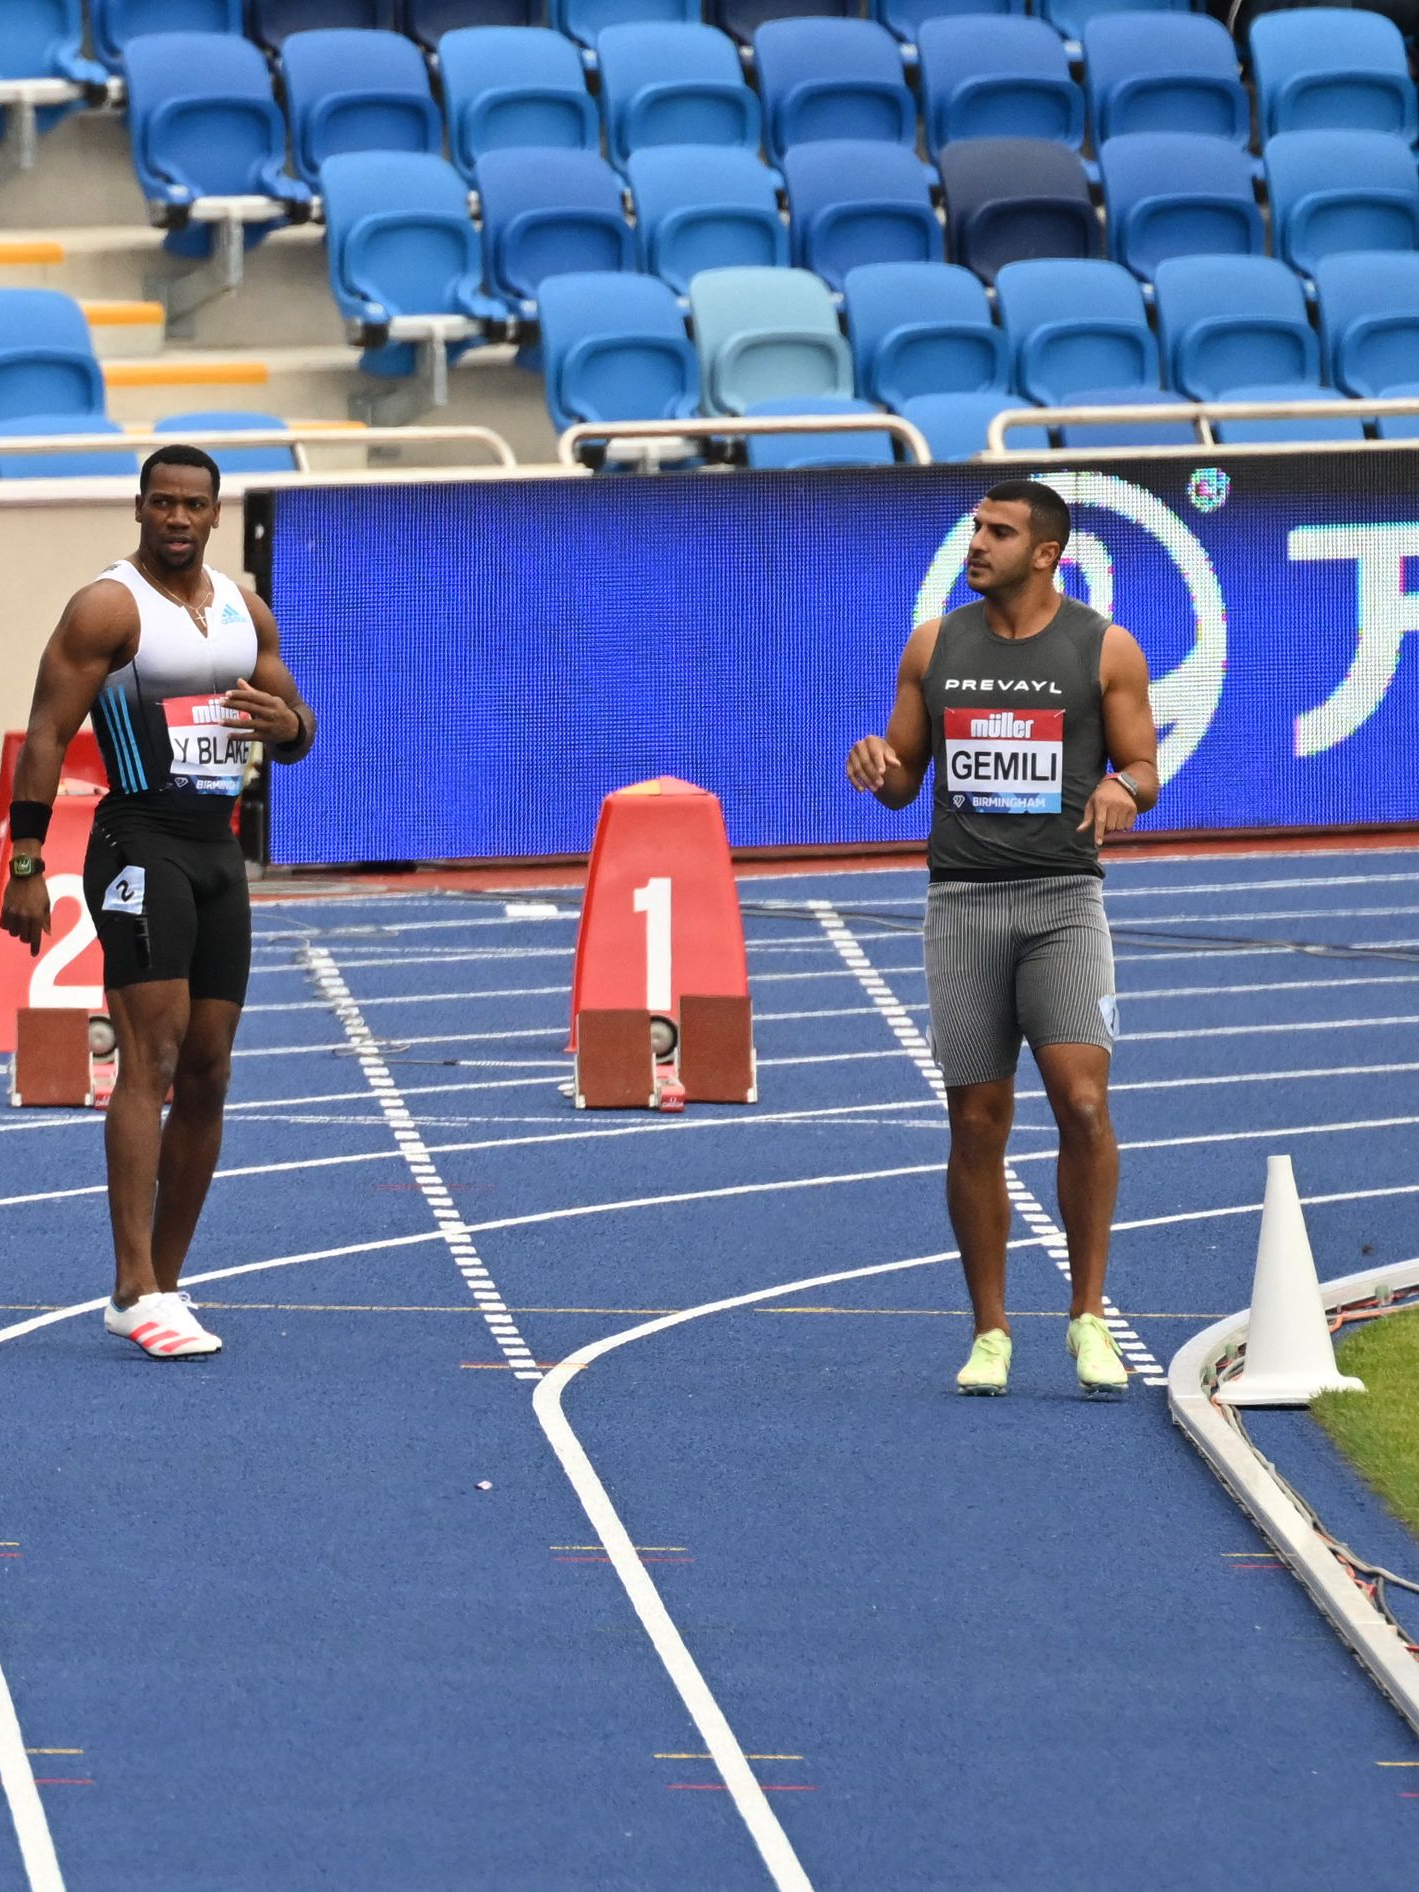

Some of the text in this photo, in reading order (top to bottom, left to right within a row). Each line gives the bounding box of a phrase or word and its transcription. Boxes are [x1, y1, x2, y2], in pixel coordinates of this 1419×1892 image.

[945, 679, 1063, 694] PREVAYL
[970, 711, 1035, 739] müller
[174, 737, 190, 764] Y
[951, 750, 1057, 782] GEMILI
[972, 796, 1046, 808] BIRMINGHAM
[115, 879, 136, 902] 2
[29, 873, 104, 1008] 2
[633, 877, 672, 1011] 1
